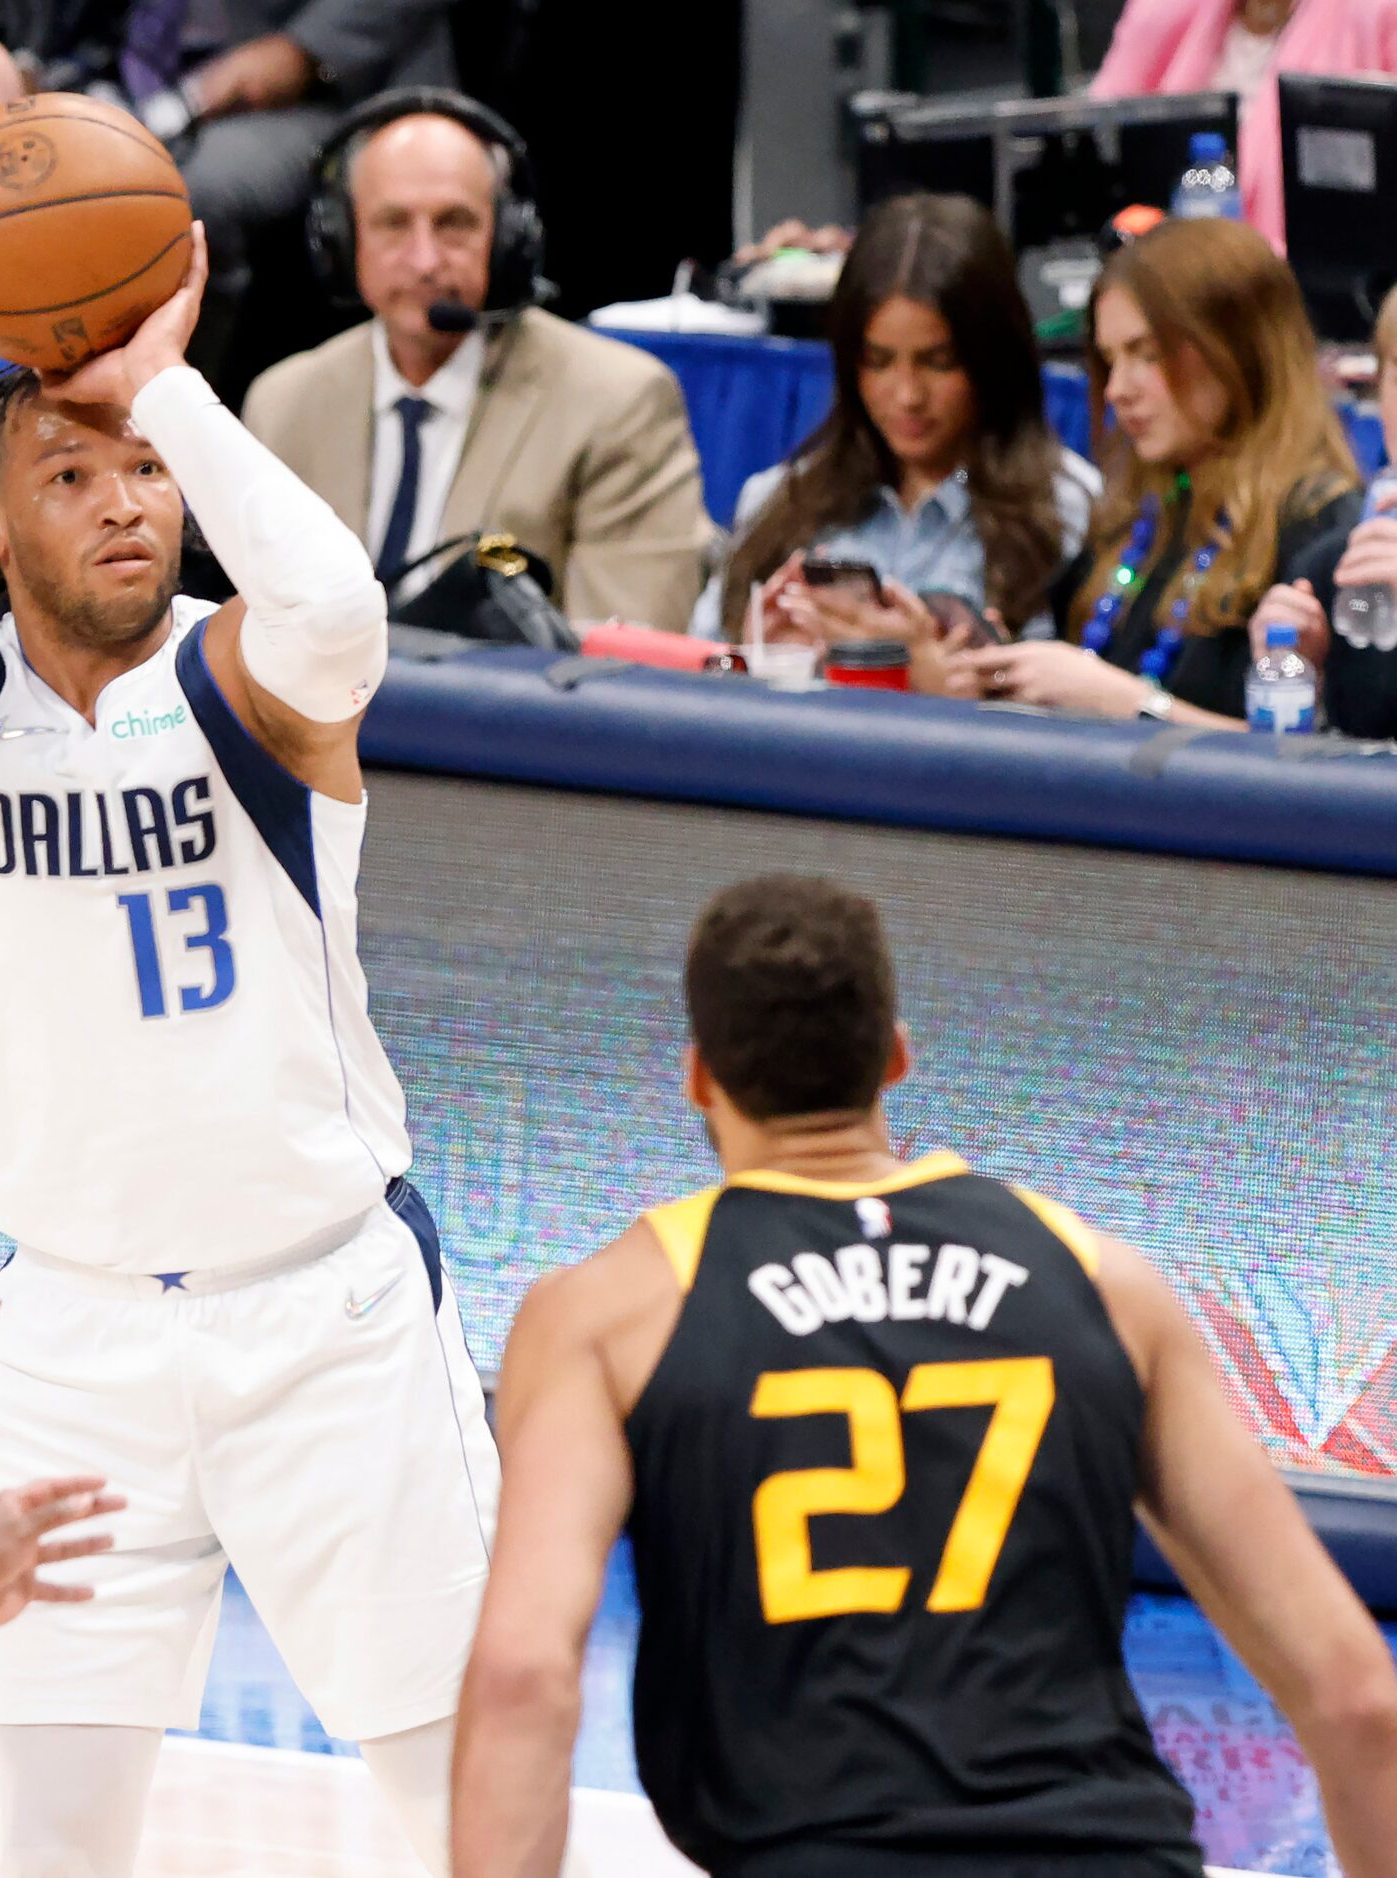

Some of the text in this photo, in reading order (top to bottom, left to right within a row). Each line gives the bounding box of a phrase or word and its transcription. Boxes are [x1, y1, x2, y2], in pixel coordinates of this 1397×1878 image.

[111, 704, 187, 739] chime
[118, 883, 237, 1019] 13
[749, 1243, 1030, 1336] GOBERT
[749, 1357, 1054, 1625] 27
